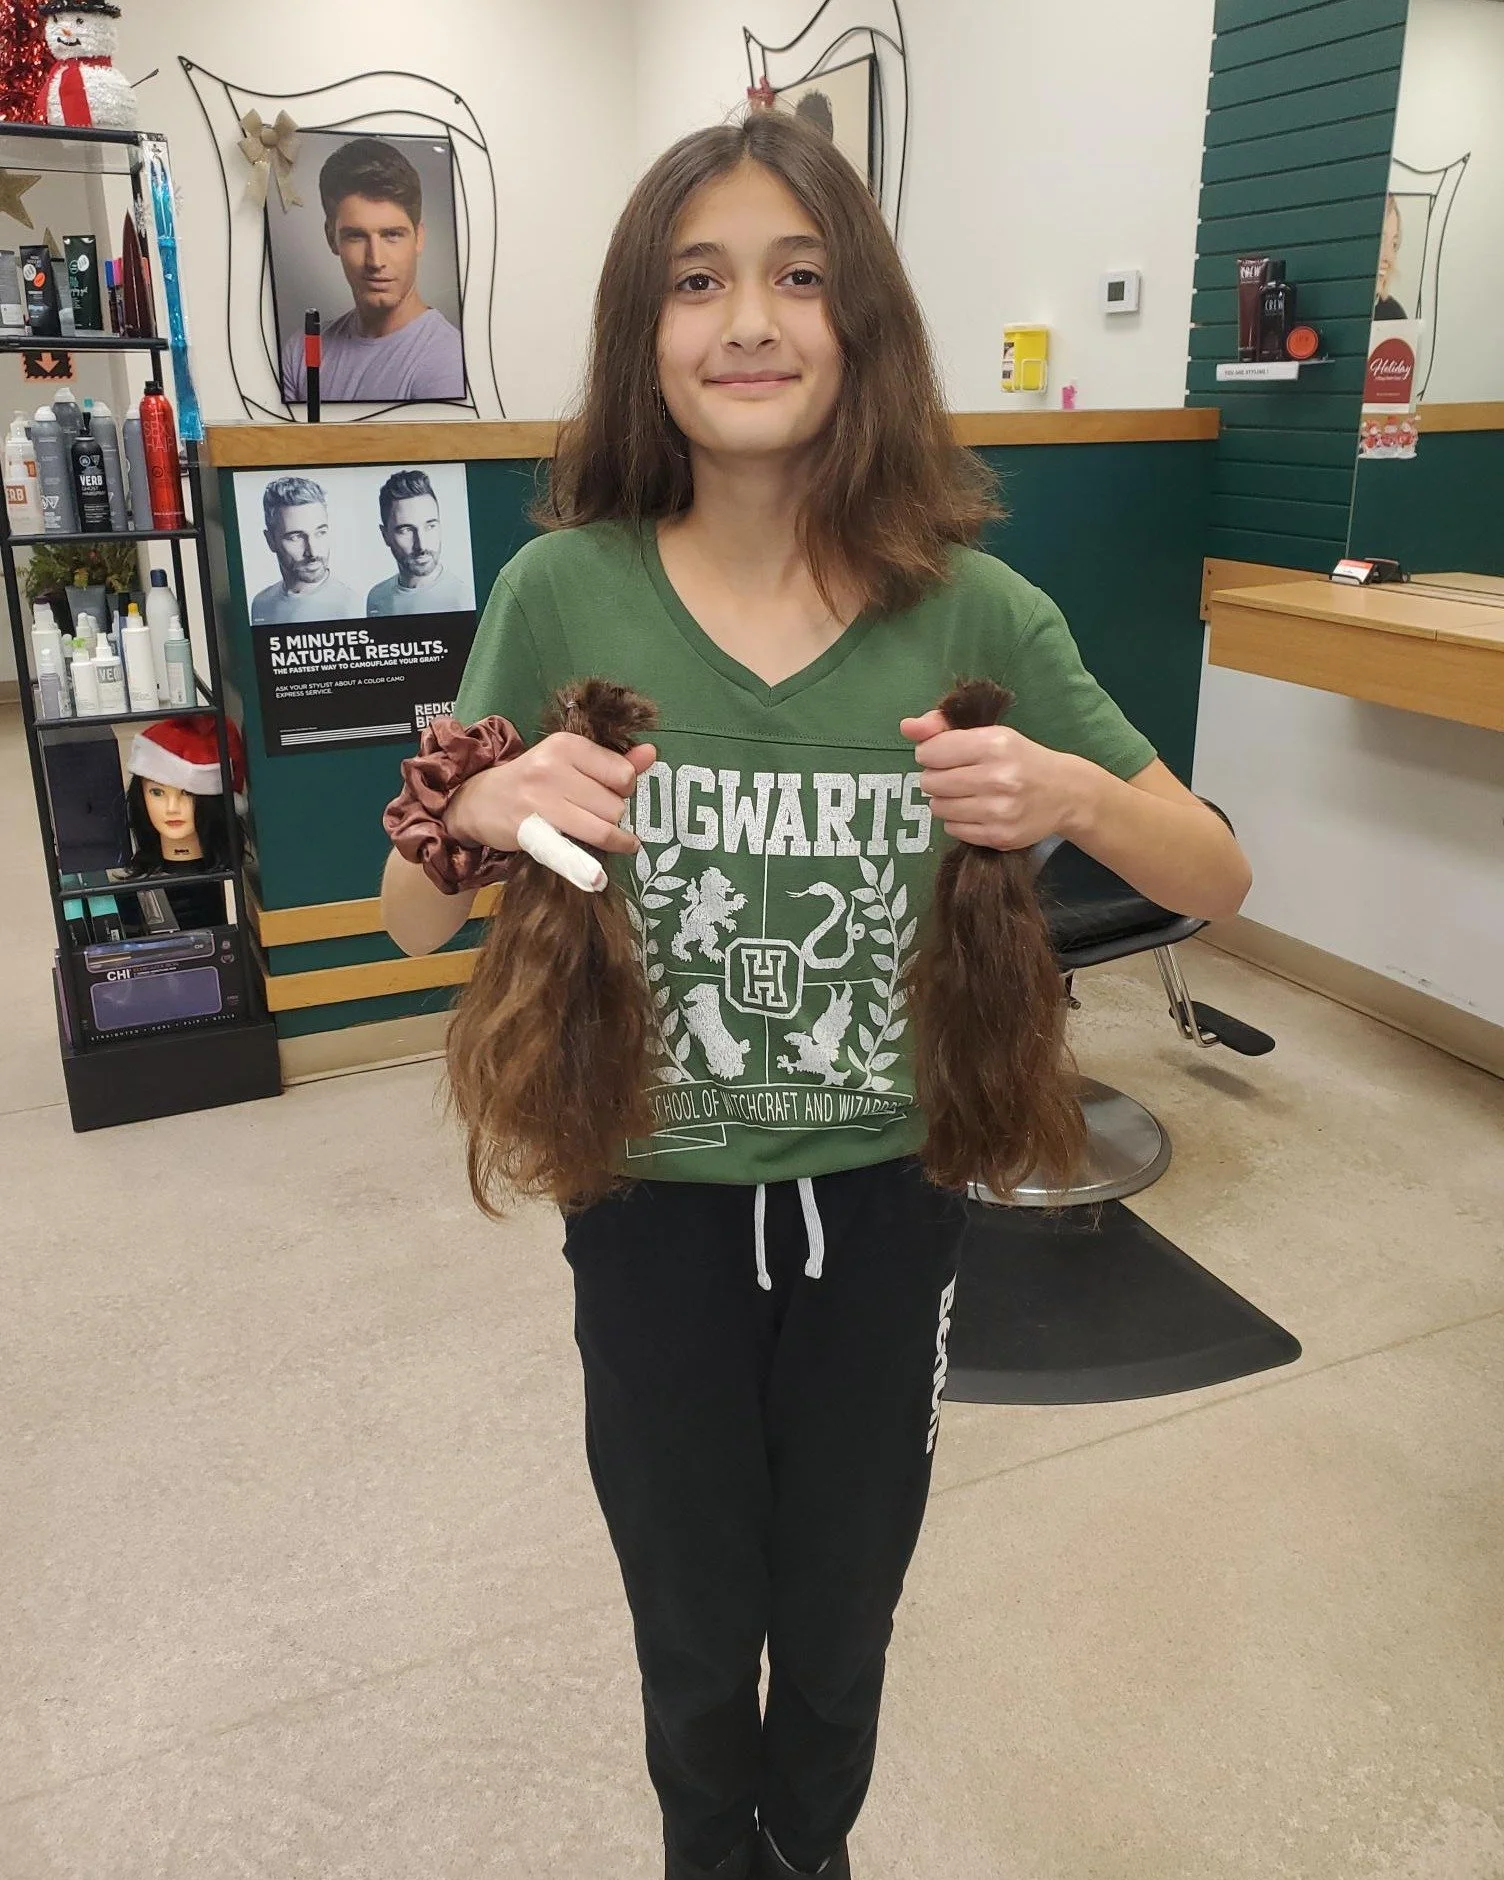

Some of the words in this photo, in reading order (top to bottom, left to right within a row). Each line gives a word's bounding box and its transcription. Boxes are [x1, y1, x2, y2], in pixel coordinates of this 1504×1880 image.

[1265, 300, 1284, 311] CREW
[1370, 357, 1411, 380] Holiday
[80, 475, 103, 486] VERB
[270, 636, 281, 651] 5
[286, 630, 375, 650] MINUTES.
[271, 647, 361, 667] NATURAL
[365, 640, 448, 660] RESULTS.
[289, 665, 320, 674] FASTEST
[320, 664, 338, 672] WAY
[350, 659, 399, 669] CAMOUFLAGE
[399, 657, 419, 666] YOUR
[289, 683, 308, 691] YOUR
[308, 681, 334, 690] STYLIST
[334, 679, 356, 688] ABOUT
[363, 677, 386, 685] COLOR
[385, 675, 405, 683] CAMO
[275, 690, 305, 699] EXPRESS
[620, 760, 932, 857] OGWARTS
[107, 968, 130, 981] CHI
[741, 948, 787, 1008] H
[702, 1089, 719, 1118] OF
[719, 1090, 799, 1122] WITCHCRAFT
[805, 1091, 833, 1122] AND
